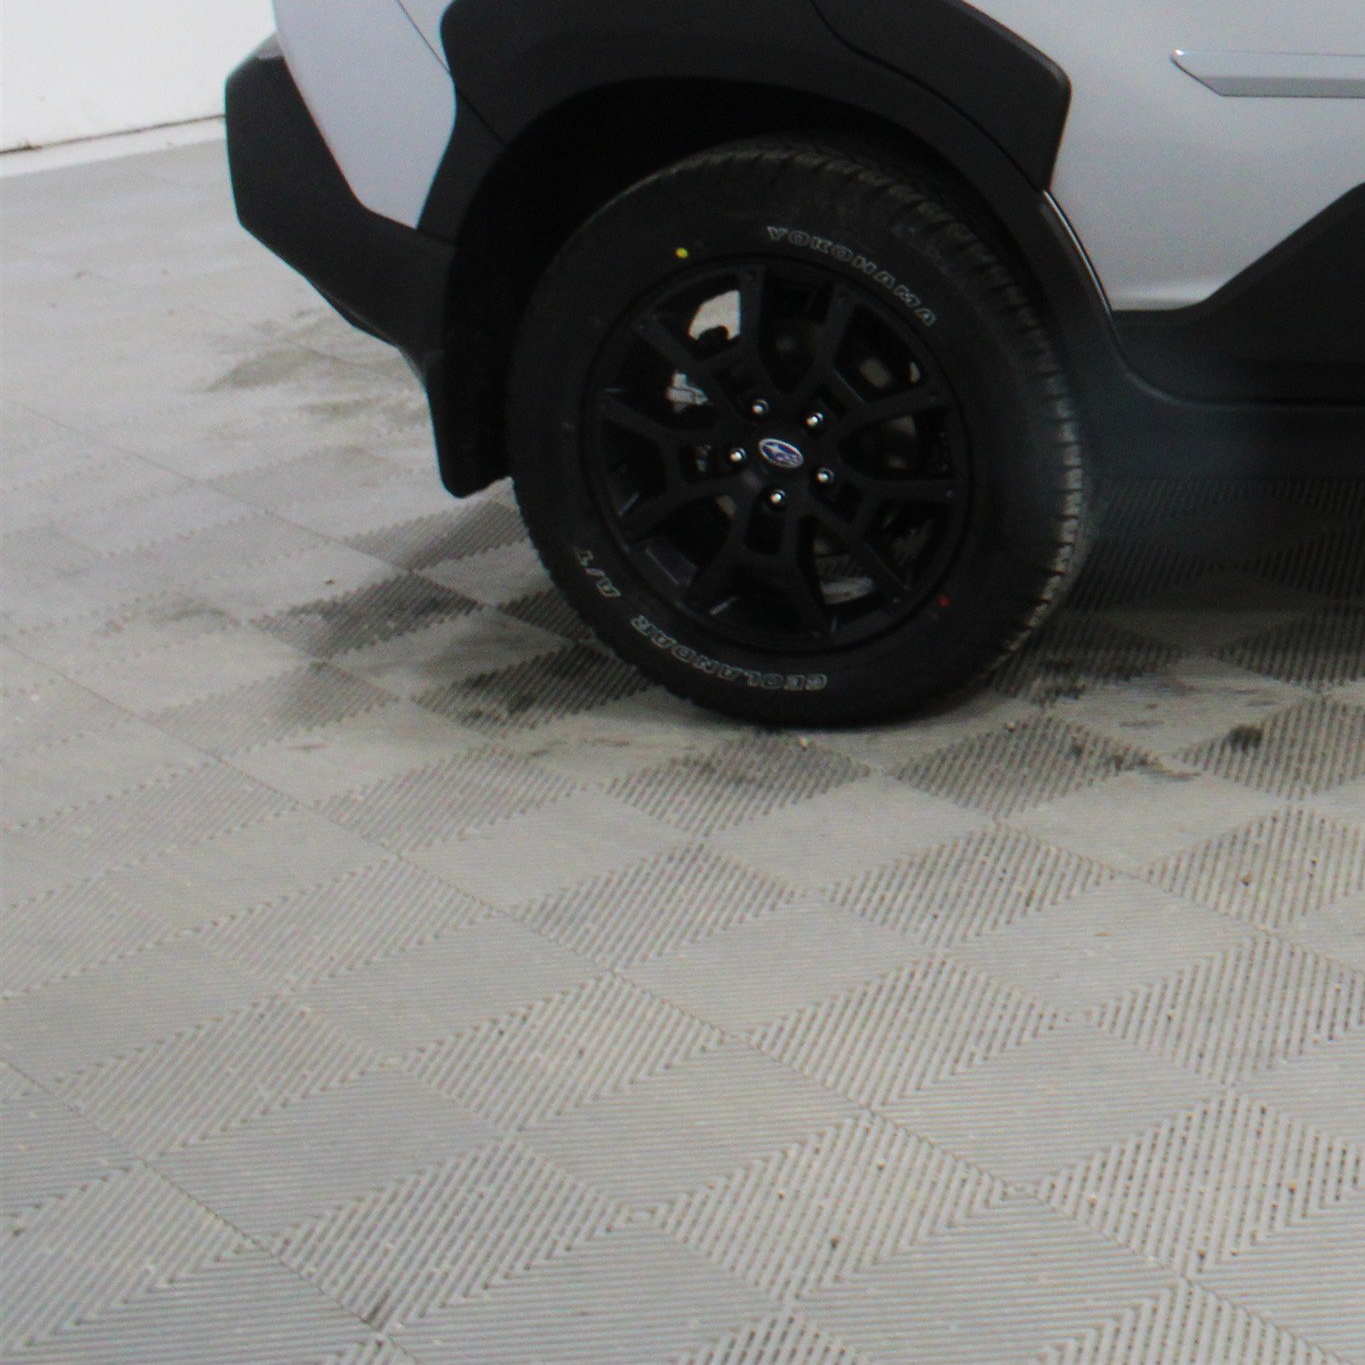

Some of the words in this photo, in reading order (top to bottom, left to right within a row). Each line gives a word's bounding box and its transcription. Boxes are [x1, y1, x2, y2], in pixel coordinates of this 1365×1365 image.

[765, 226, 938, 327] YOKOHAMA
[574, 548, 622, 599] A/T
[630, 614, 828, 692] GEOLANDAR
